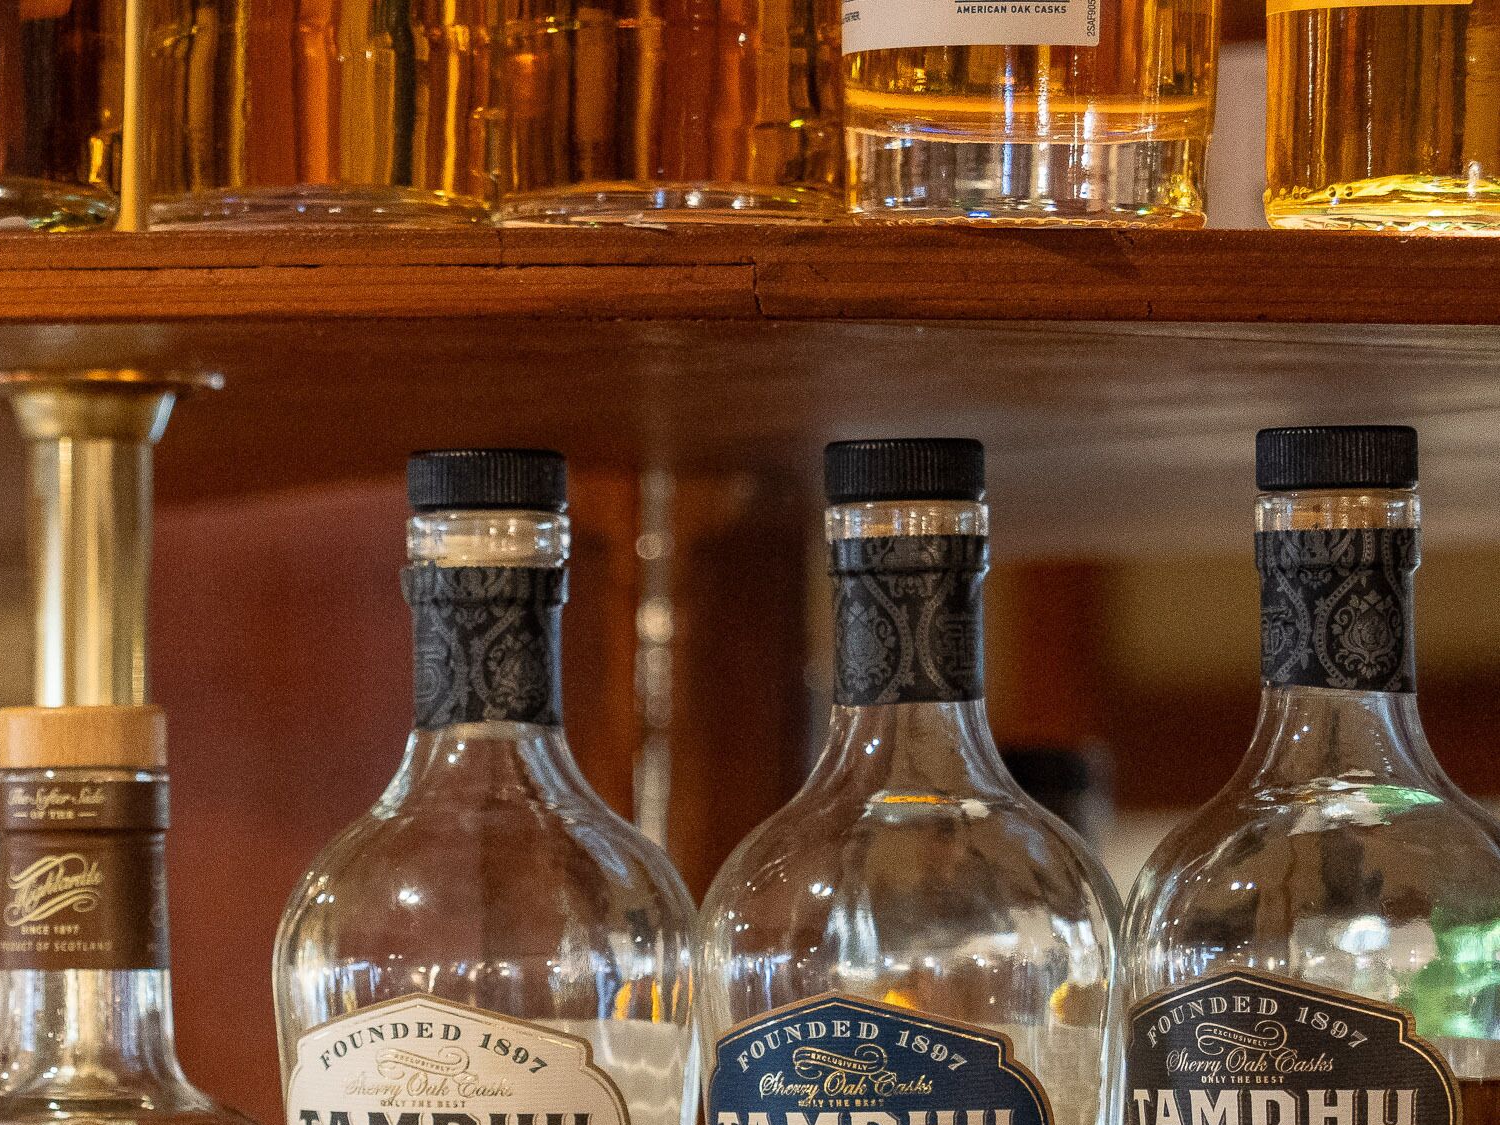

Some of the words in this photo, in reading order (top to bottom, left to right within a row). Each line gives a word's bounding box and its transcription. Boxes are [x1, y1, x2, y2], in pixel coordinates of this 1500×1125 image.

[956, 5, 1007, 14] AMERICAN
[1010, 5, 1031, 14] OAK
[1034, 5, 1067, 14] CASKS
[1146, 995, 1279, 1049] FOUNDED
[1296, 1006, 1368, 1050] 1897
[320, 1021, 462, 1071] FOUNDED
[478, 1032, 548, 1075] 1897
[736, 1019, 880, 1073] FOUNDED
[896, 1029, 968, 1072] 1897
[1212, 1028, 1269, 1047] EXCLUSIVELY
[810, 1053, 869, 1071] EXCLUSIVELY
[1166, 1047, 1222, 1077] Sherry
[1226, 1047, 1268, 1073] Oak
[1269, 1047, 1334, 1073] Casks
[345, 1071, 401, 1101] Sherry
[406, 1071, 450, 1097] Oak
[452, 1073, 514, 1098] Casks
[759, 1071, 820, 1101] Sherry
[823, 1070, 868, 1097] Oak
[869, 1071, 933, 1097] Casks
[1201, 1075, 1226, 1084] ONLY
[1231, 1075, 1251, 1084] THE
[1255, 1075, 1284, 1084] BEST
[412, 1099, 432, 1109] THE
[437, 1099, 466, 1109] BEST
[828, 1099, 850, 1108] THE
